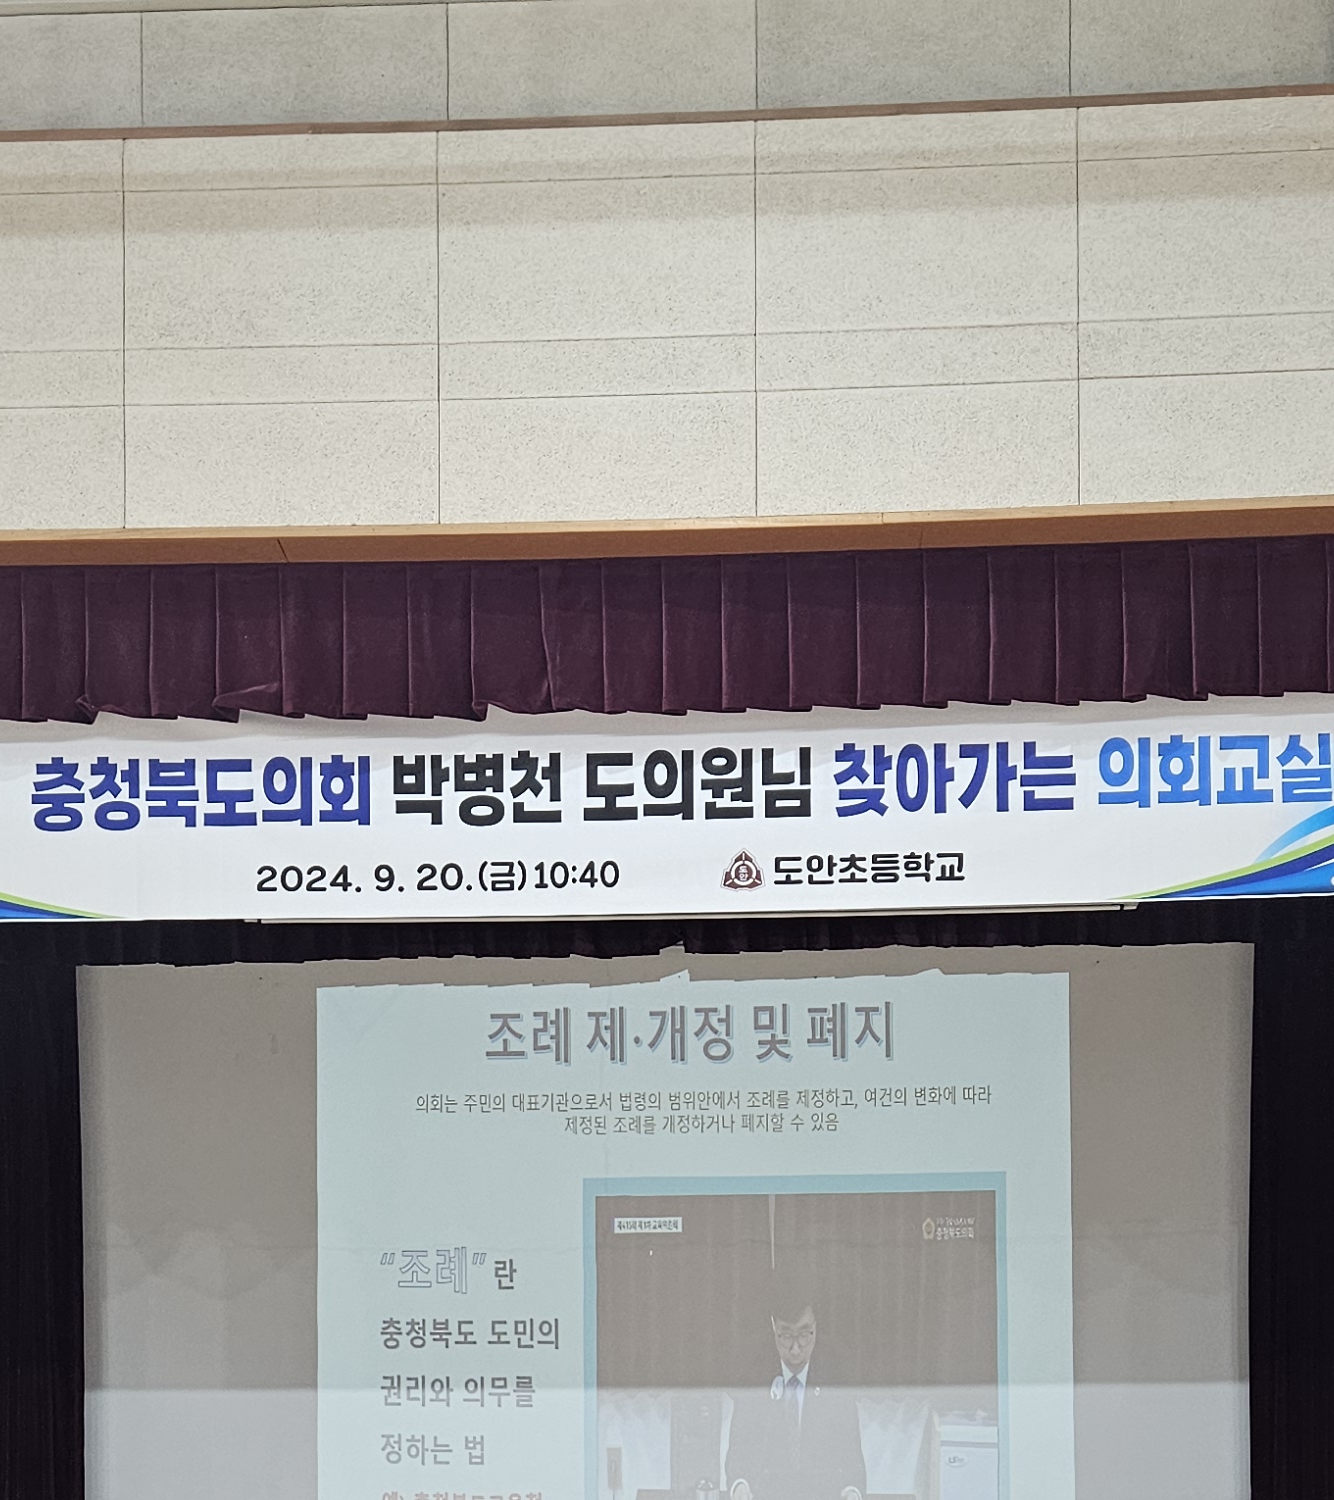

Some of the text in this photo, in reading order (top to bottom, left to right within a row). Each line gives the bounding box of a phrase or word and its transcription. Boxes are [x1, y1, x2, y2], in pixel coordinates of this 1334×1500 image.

[32, 733, 1334, 831] 충청북도의회 박병천 도의원님 찾아가는 의회교실
[257, 860, 619, 892] 2024. 9. 20.(금) 10:40
[774, 852, 965, 884] 도안초등학교
[486, 1002, 891, 1065] 조례 제·개정 및 폐지
[416, 1086, 991, 1113] 의회는 주민의 대표기관으로서 법령의 범위안에서 조례를 제정하고, 여건의 변화에 따라
[565, 1113, 838, 1135] 제정된 조례를 개정하거나 폐지할 수 있음
[381, 1318, 559, 1349] 충청북도 도민의
[381, 1375, 535, 1407] 권리와 의무를
[381, 1433, 484, 1466] 정하는 법
